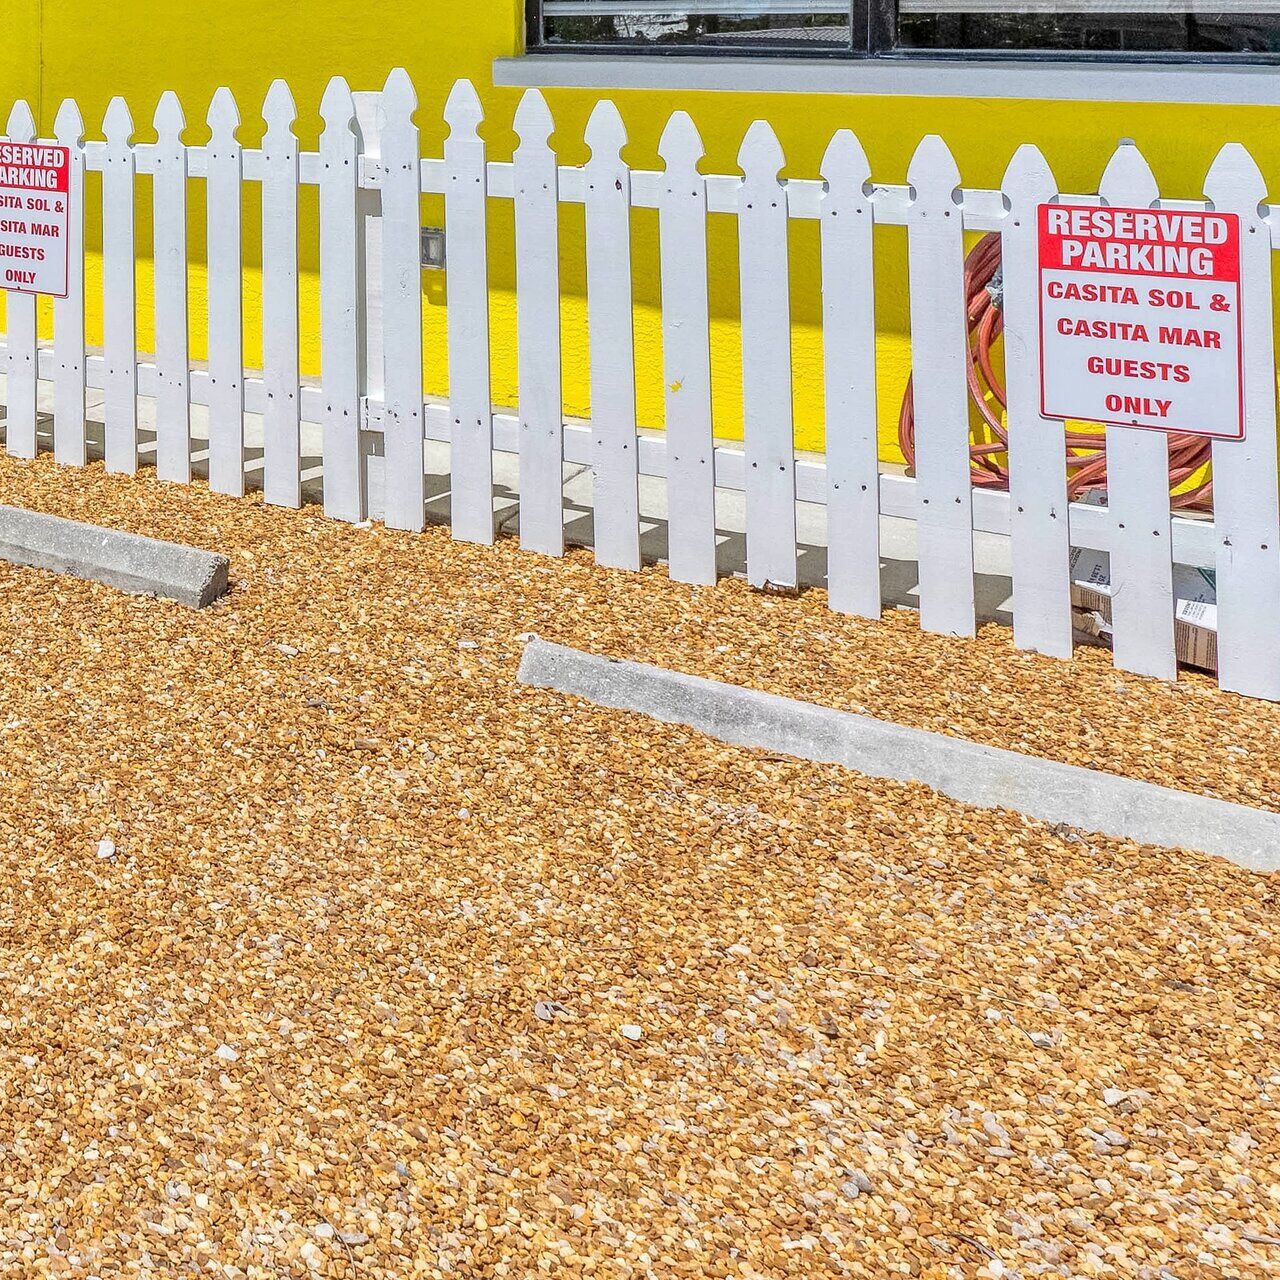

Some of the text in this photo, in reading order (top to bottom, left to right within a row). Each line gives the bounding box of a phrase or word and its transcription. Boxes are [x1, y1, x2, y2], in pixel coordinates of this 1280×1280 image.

[26, 198, 51, 212] SOL
[54, 200, 64, 213] &
[31, 222, 60, 237] MAR
[1047, 209, 1229, 245] RESERVED
[1061, 239, 1214, 276] PARKING
[5, 269, 37, 284] ONLY
[1047, 281, 1231, 312] CASITA SOL &
[1057, 317, 1222, 349] CASITA MAR
[1087, 356, 1190, 383] GUESTS
[1105, 394, 1172, 417] ONLY
